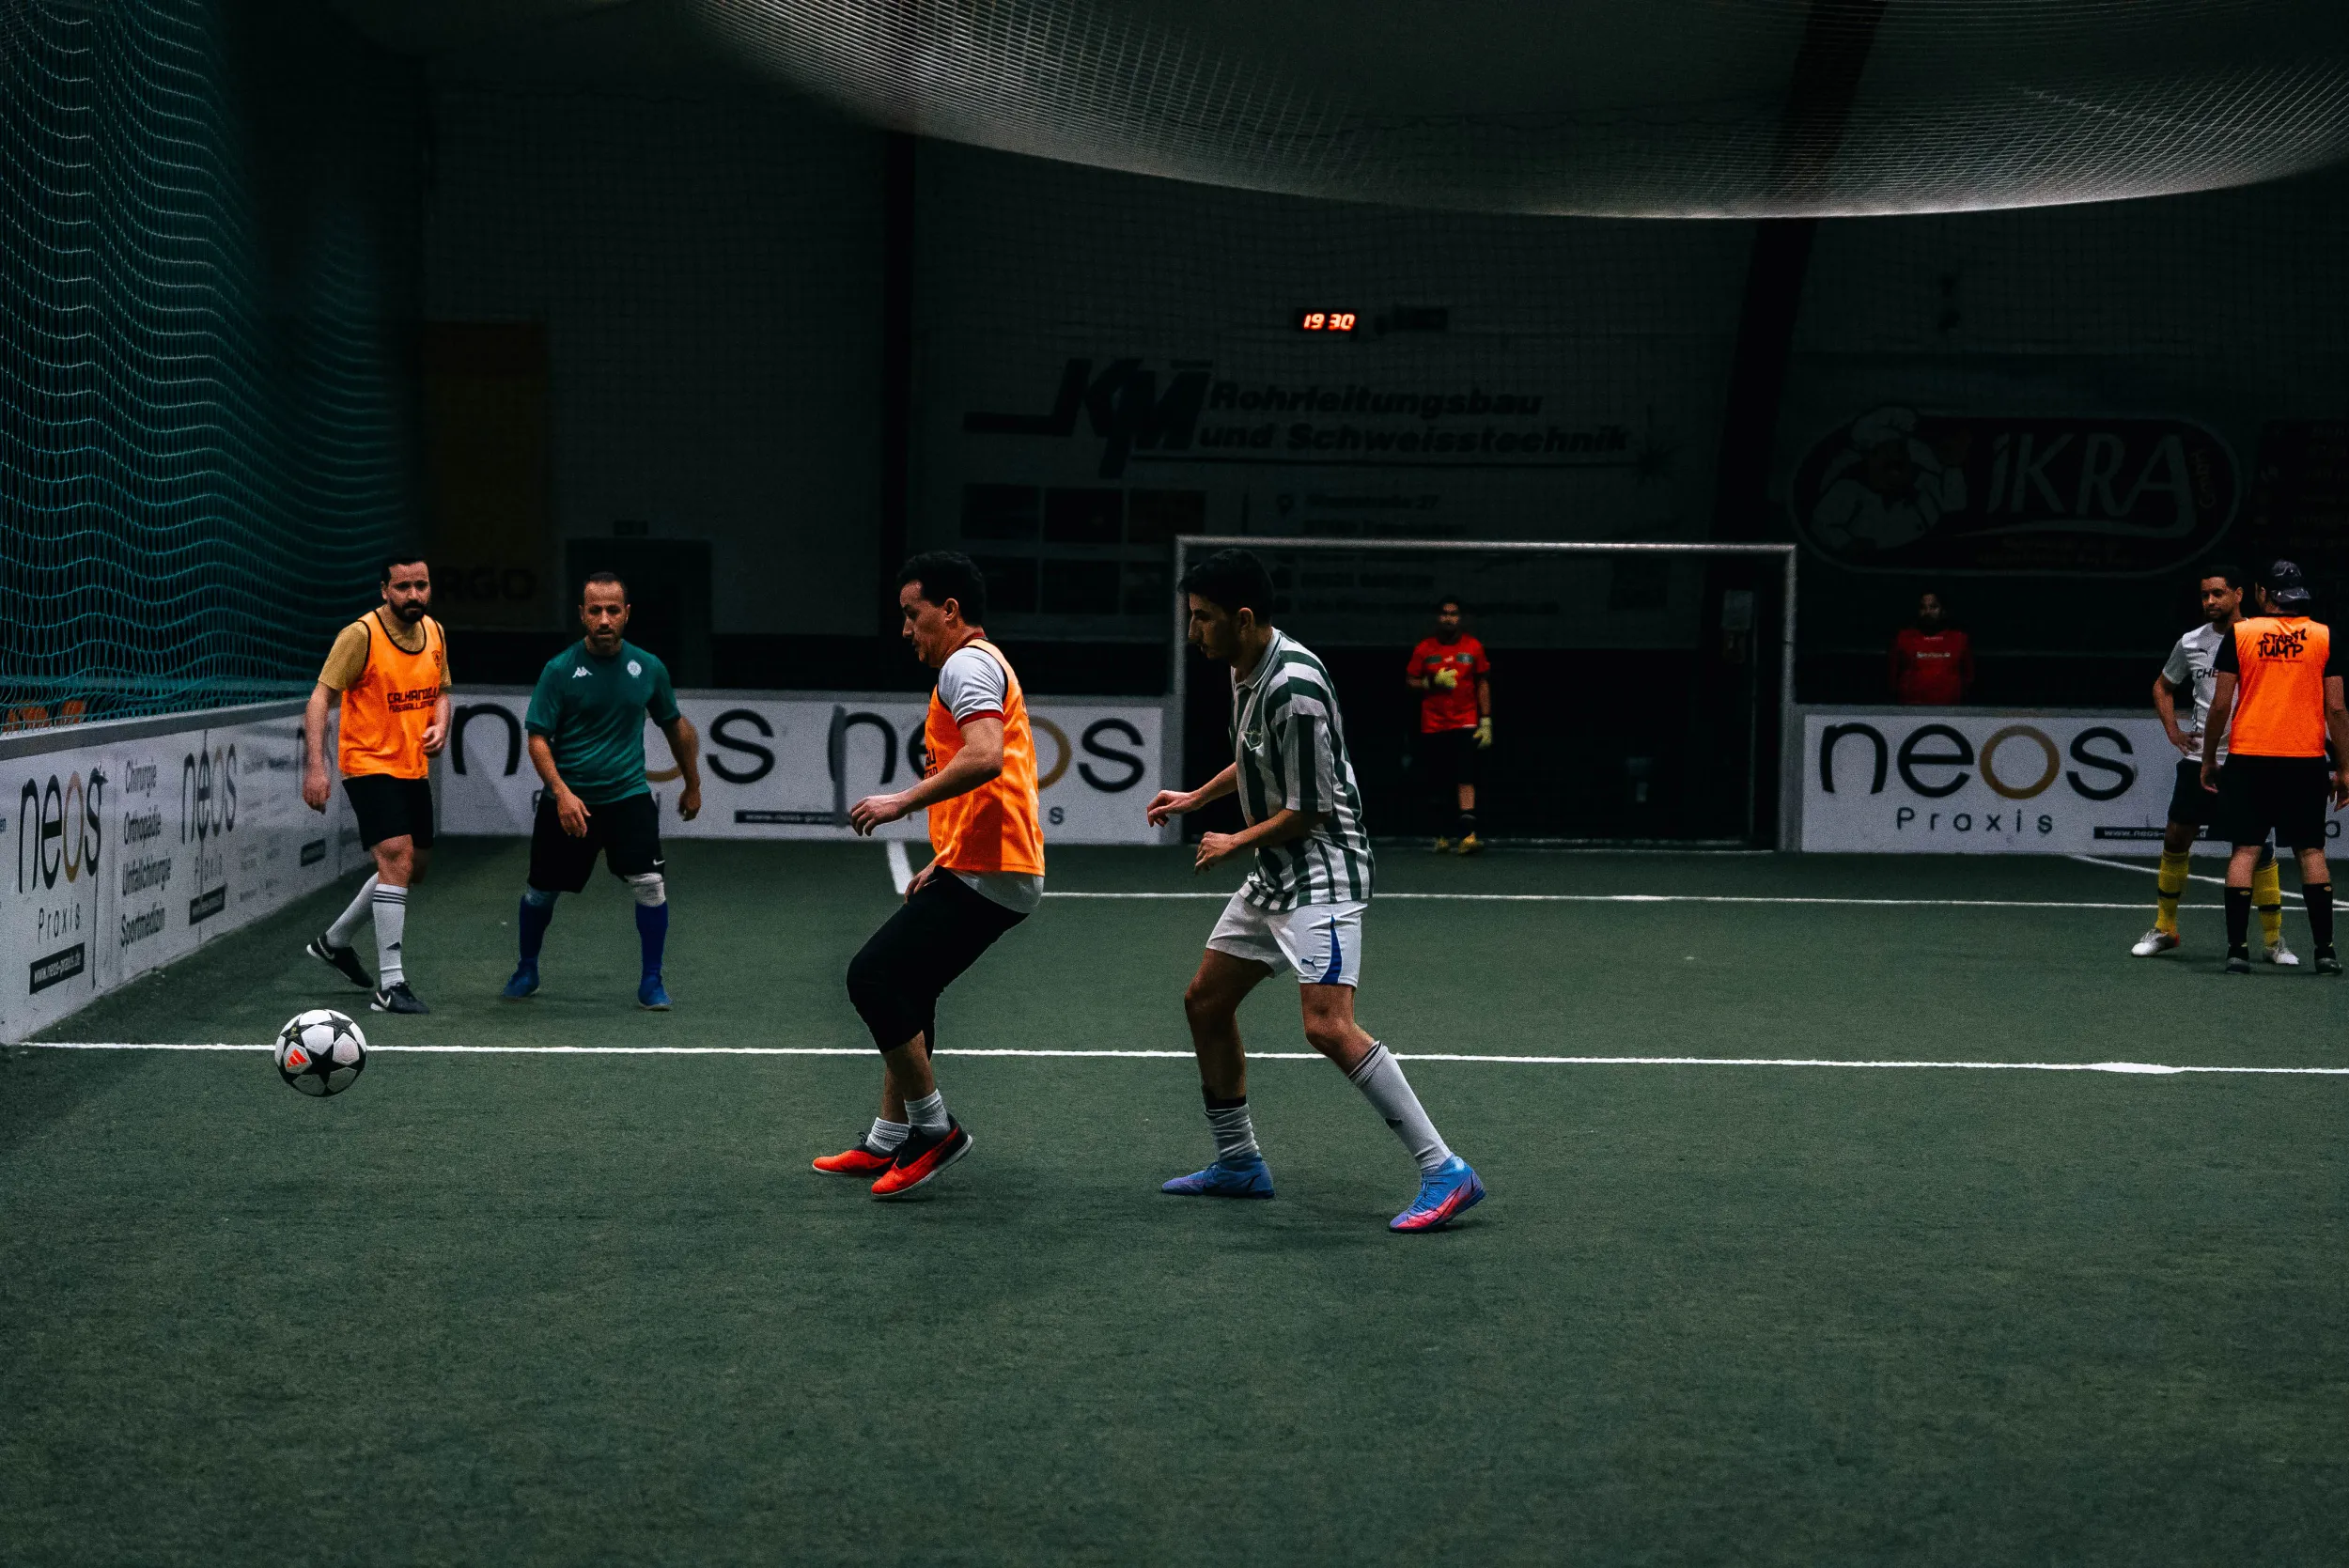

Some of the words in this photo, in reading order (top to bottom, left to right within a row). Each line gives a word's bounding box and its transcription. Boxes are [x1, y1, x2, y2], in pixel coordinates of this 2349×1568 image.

[1209, 382, 1544, 419] Rohrleitungsbau
[1199, 424, 1272, 449] und
[1287, 424, 1627, 453] Schweisstechnik
[436, 567, 538, 602] RGO
[2257, 640, 2304, 659] JUMP
[2196, 668, 2218, 679] CHE
[1820, 722, 2134, 800] neos
[181, 743, 237, 845] neos
[19, 768, 103, 893] neos
[1897, 807, 2053, 832] Praxis
[38, 897, 81, 943] Praxis
